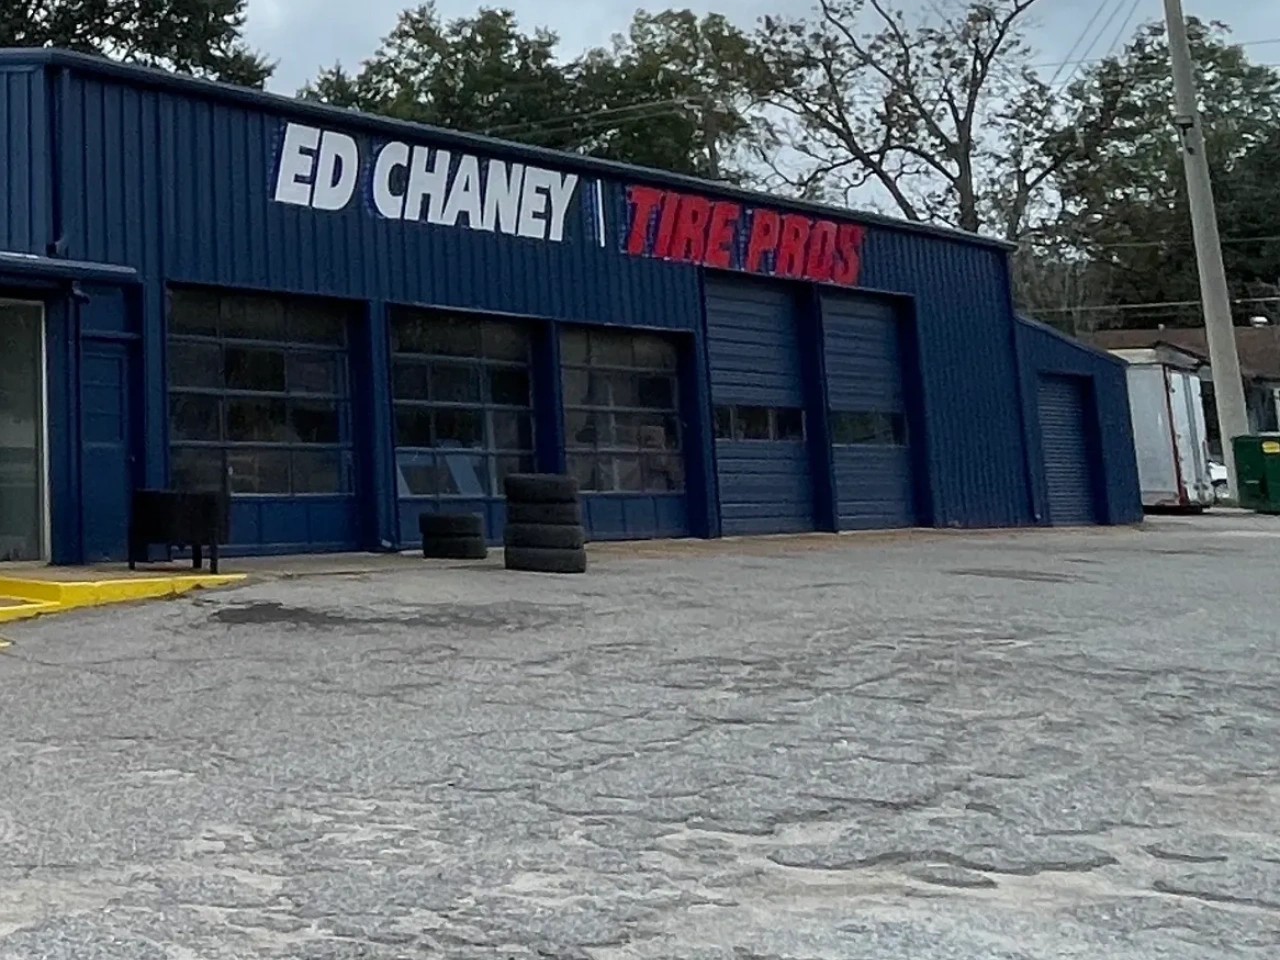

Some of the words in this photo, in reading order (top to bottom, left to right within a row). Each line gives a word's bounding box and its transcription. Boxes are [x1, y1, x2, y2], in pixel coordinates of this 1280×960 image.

[274, 122, 359, 211] ED
[372, 141, 579, 242] CHANEY
[625, 185, 740, 268] TIRE
[745, 208, 867, 286] PROS
